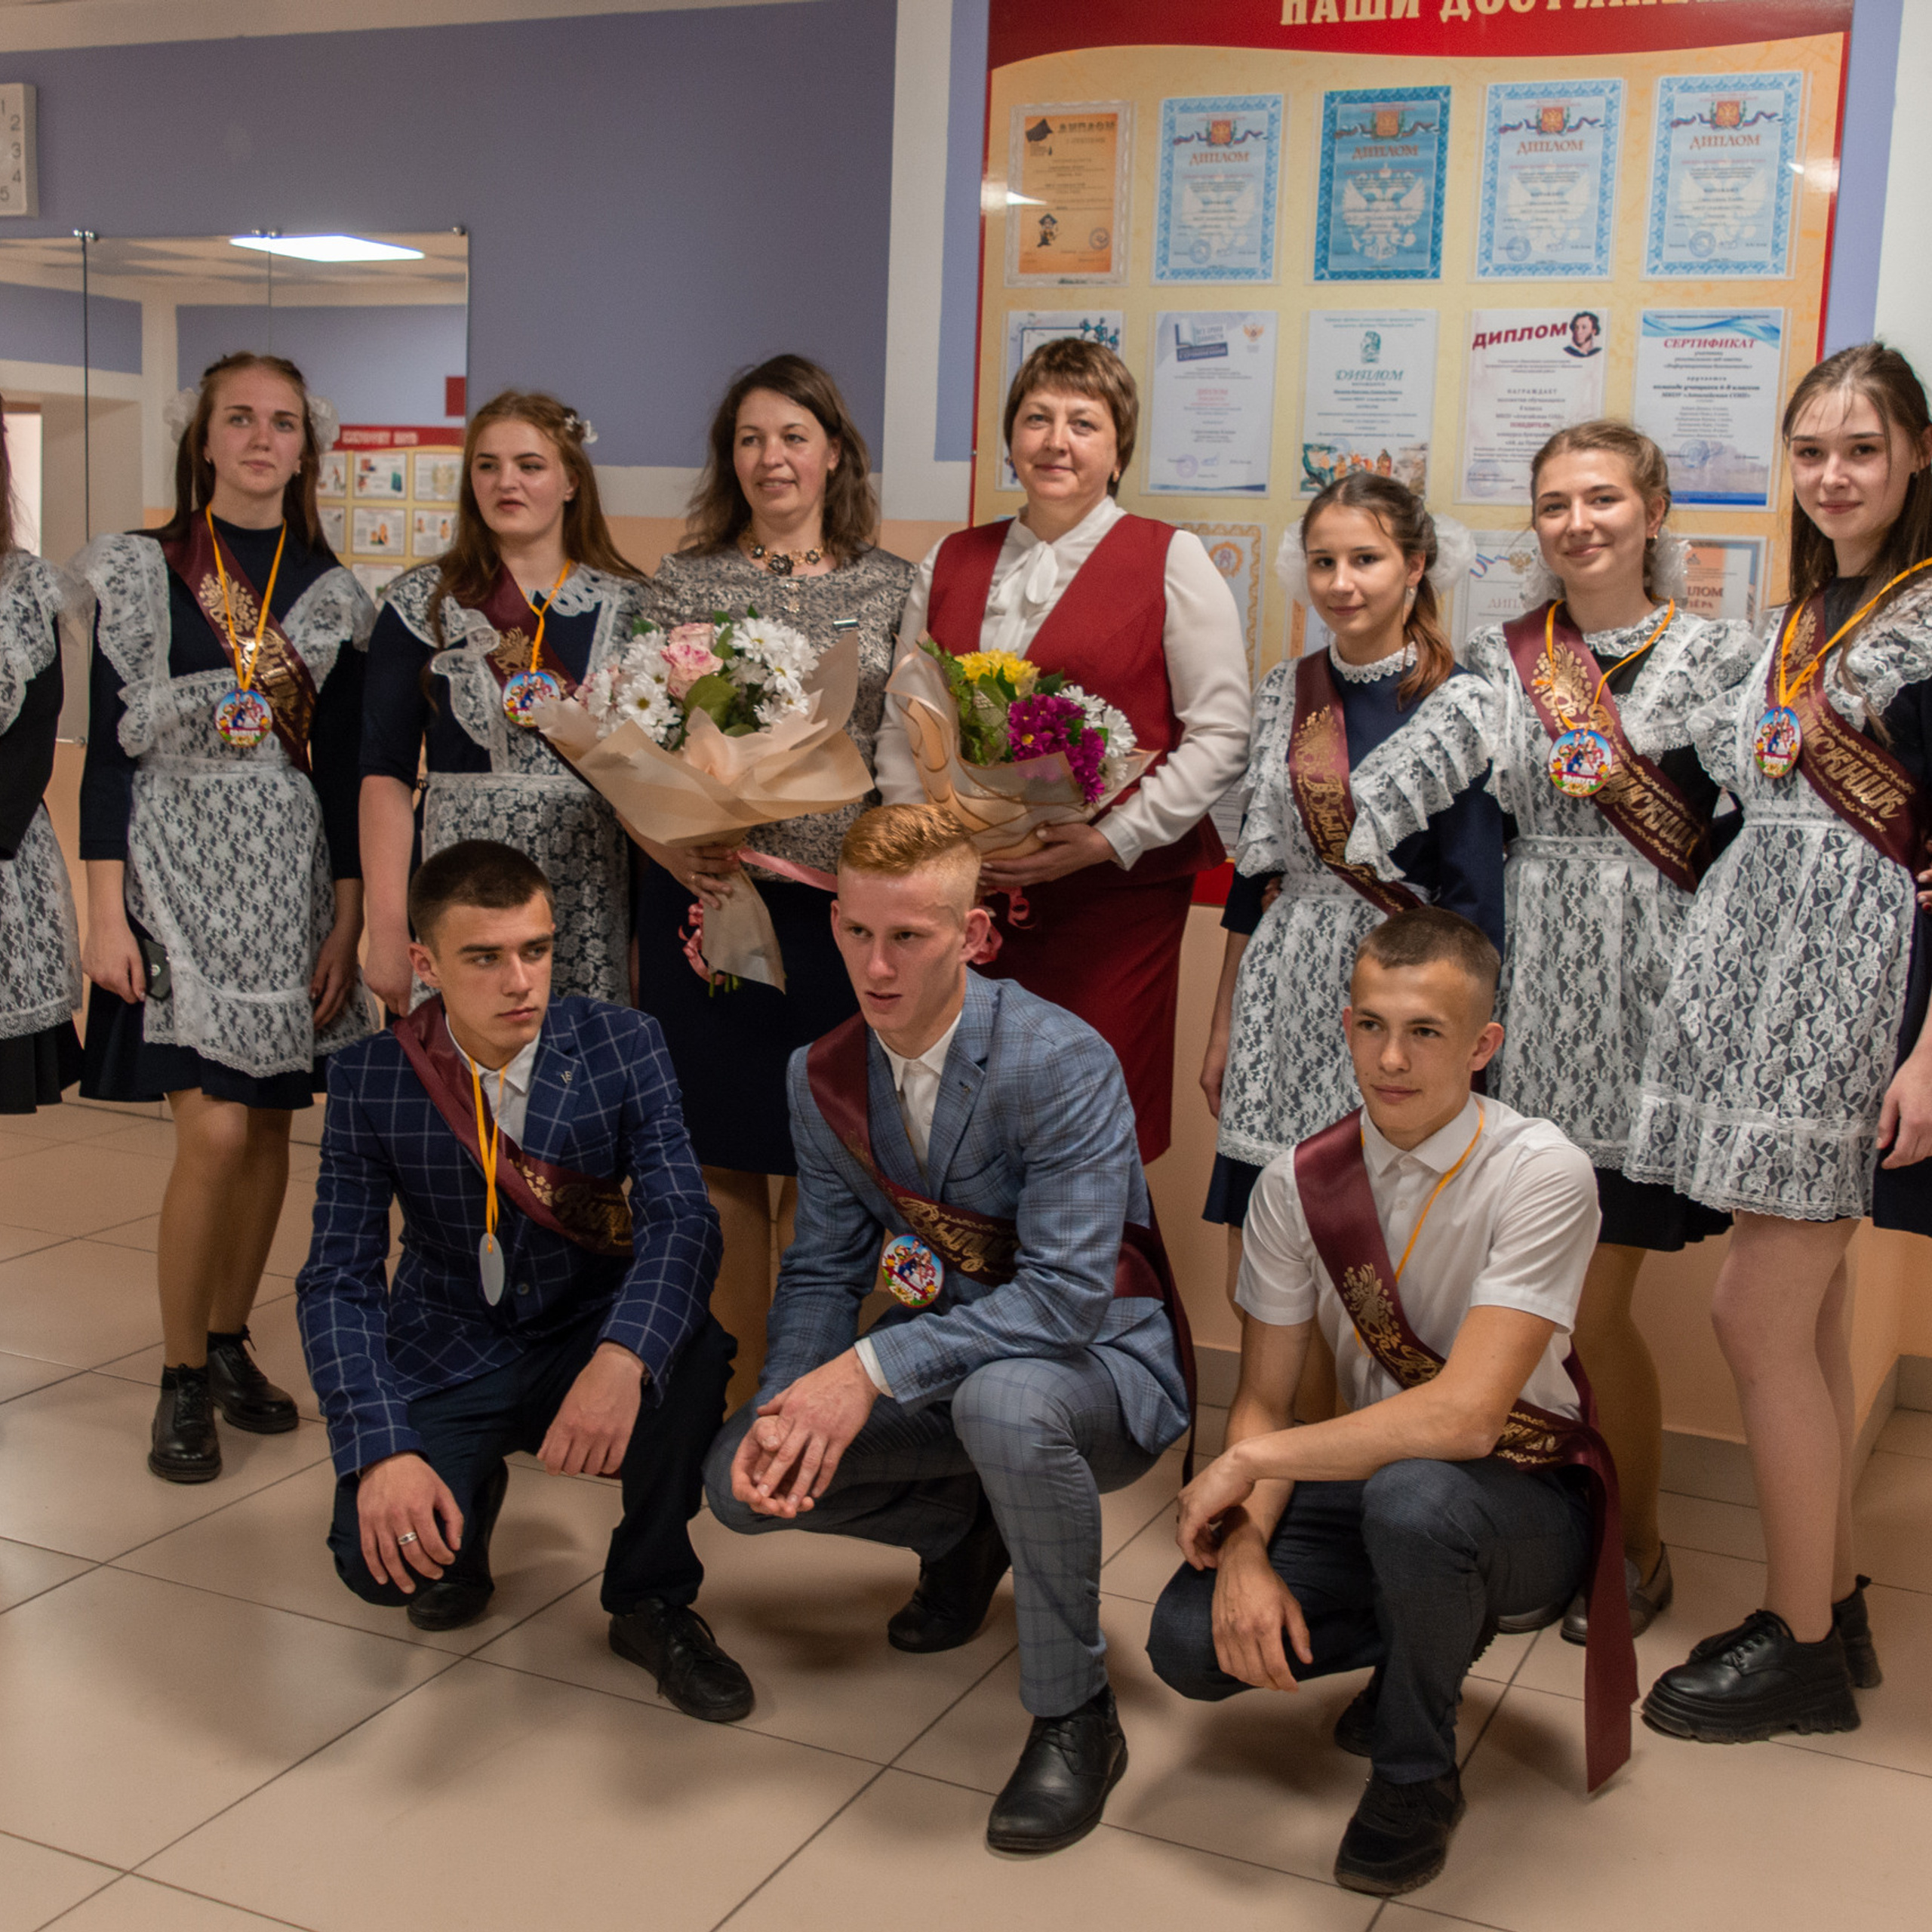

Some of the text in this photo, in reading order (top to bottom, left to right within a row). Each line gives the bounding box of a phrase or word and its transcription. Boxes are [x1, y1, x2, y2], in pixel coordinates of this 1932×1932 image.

[11, 114, 20, 131] 2
[1517, 139, 1584, 155] ДИПЛОМ
[1690, 134, 1761, 150] ДИПЛОМ
[11, 142, 22, 159] 3
[1189, 151, 1250, 166] ДИПЛОМ
[1352, 145, 1419, 161] ДИПЛОМ
[12, 168, 22, 183] 4
[0, 186, 10, 202] 5
[1472, 322, 1568, 351] ДИПЛОМ
[1663, 337, 1758, 349] СЕРТИФИКАТ
[1335, 369, 1404, 381] ДИПЛОМ
